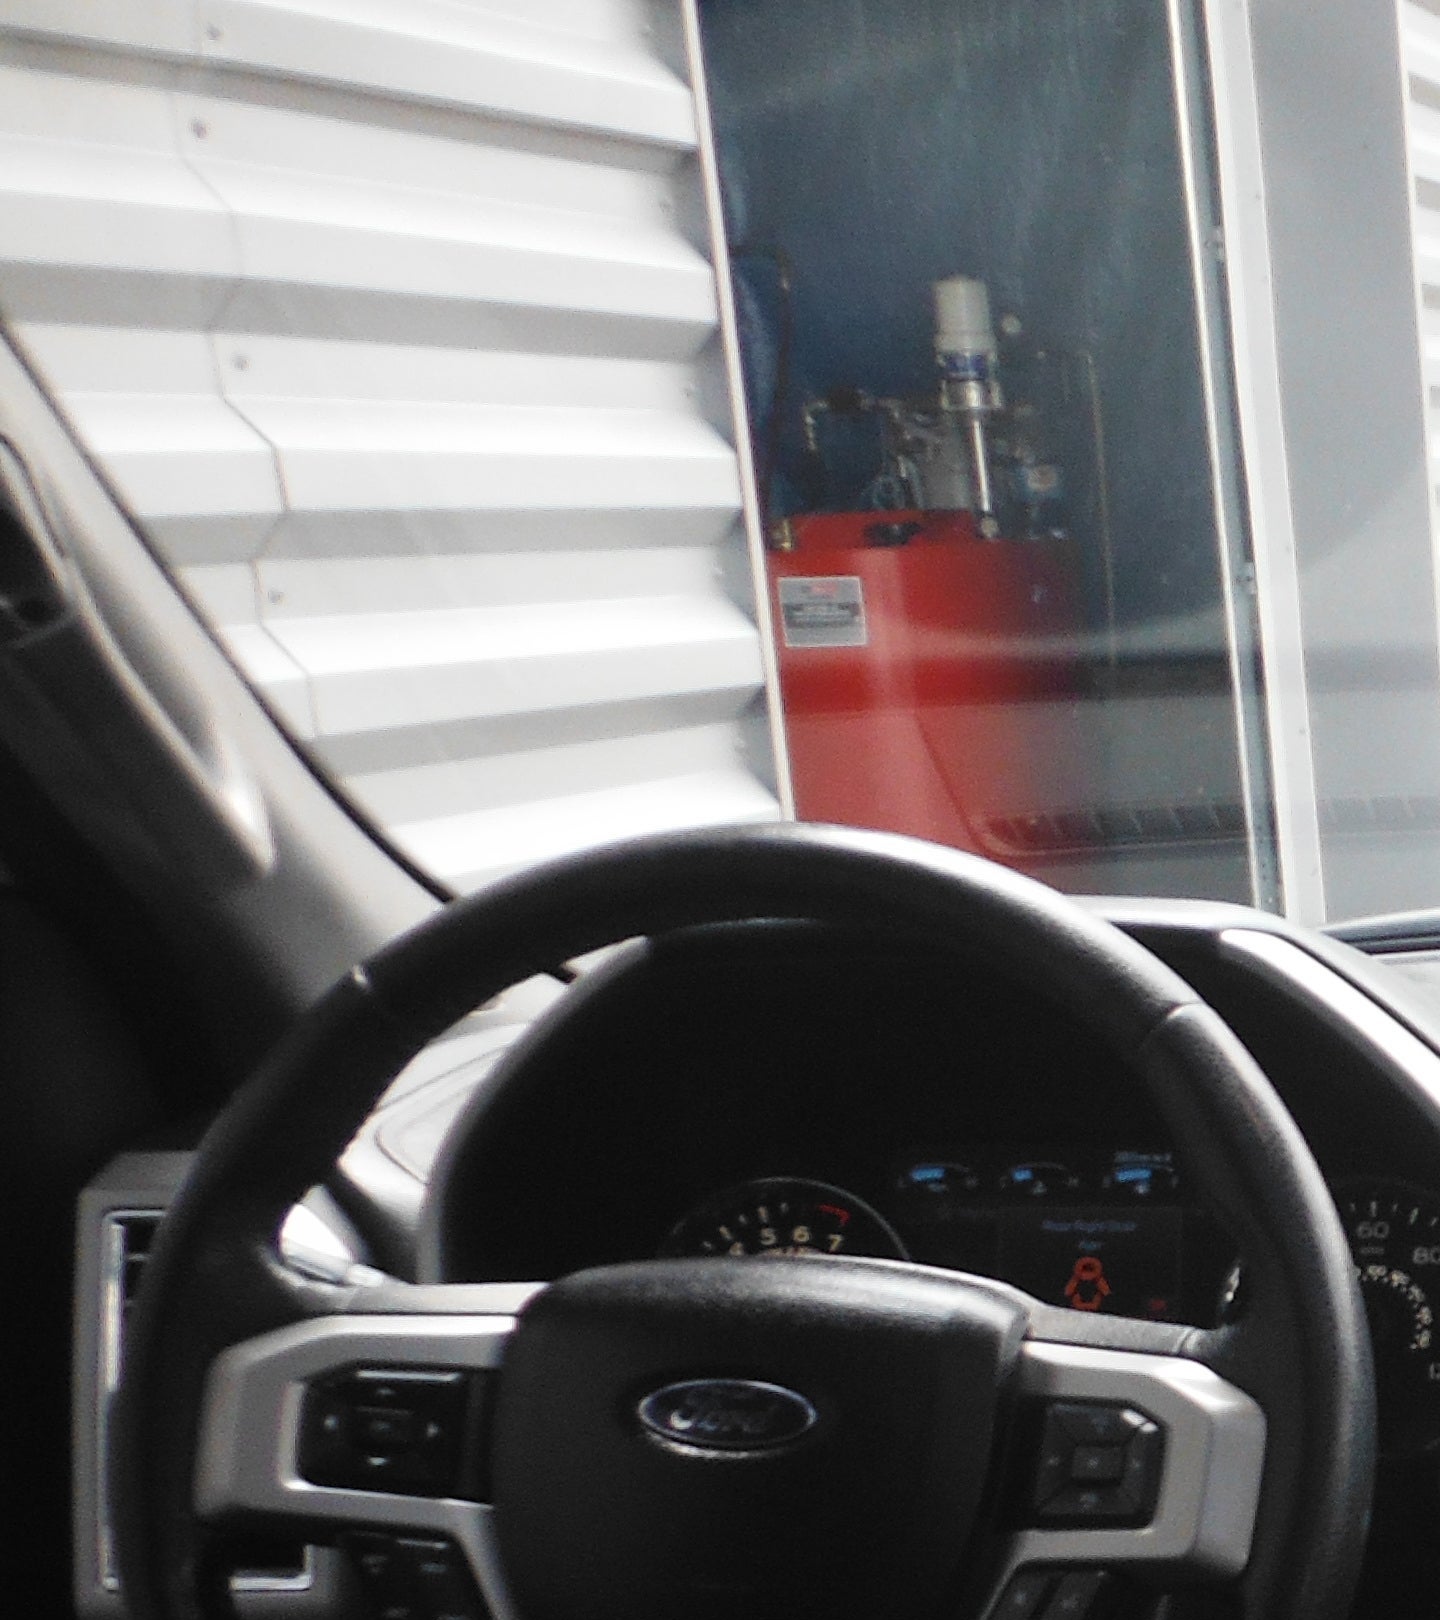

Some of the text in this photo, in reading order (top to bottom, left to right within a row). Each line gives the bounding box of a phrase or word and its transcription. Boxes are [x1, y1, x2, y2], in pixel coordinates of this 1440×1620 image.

[760, 1227, 777, 1246] 5
[792, 1225, 811, 1243] 6
[1357, 1220, 1390, 1239] 60
[827, 1233, 845, 1252] 7
